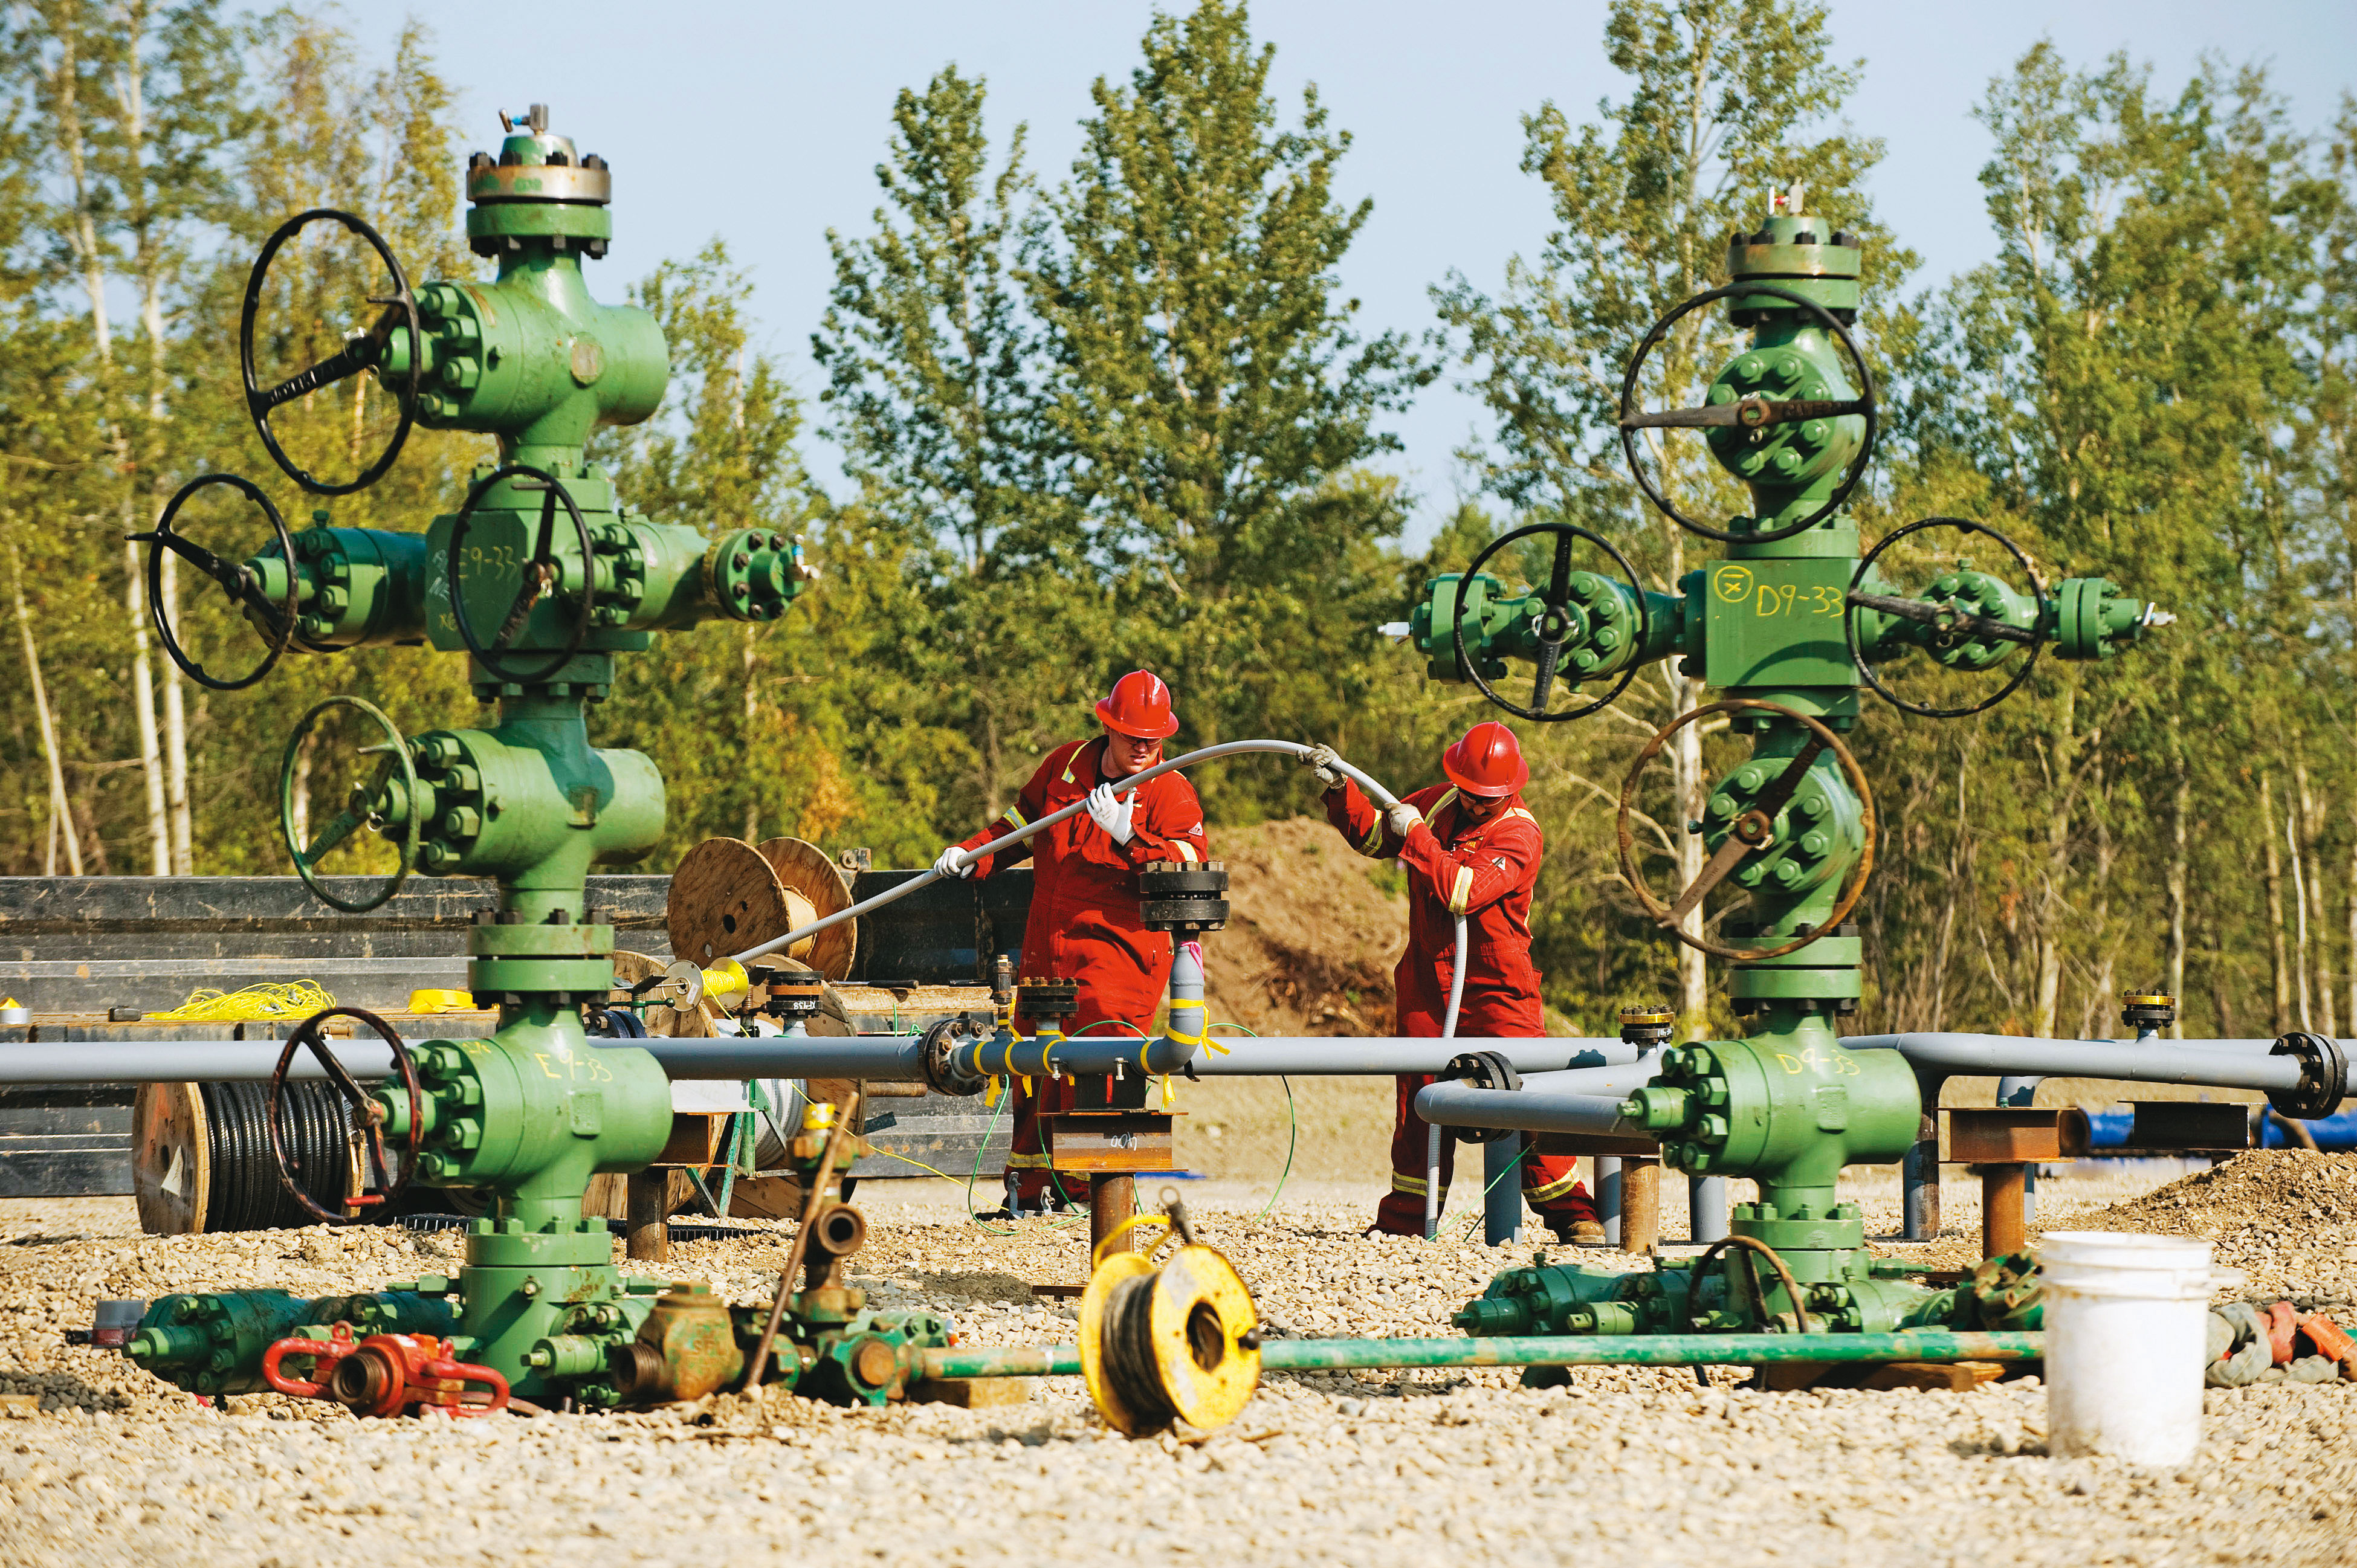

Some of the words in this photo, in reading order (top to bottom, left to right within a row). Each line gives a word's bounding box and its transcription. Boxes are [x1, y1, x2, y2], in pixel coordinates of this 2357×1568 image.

[1756, 584, 1846, 618] D9-33
[534, 1048, 613, 1082] E9-33
[1776, 1047, 1861, 1076] D9-33
